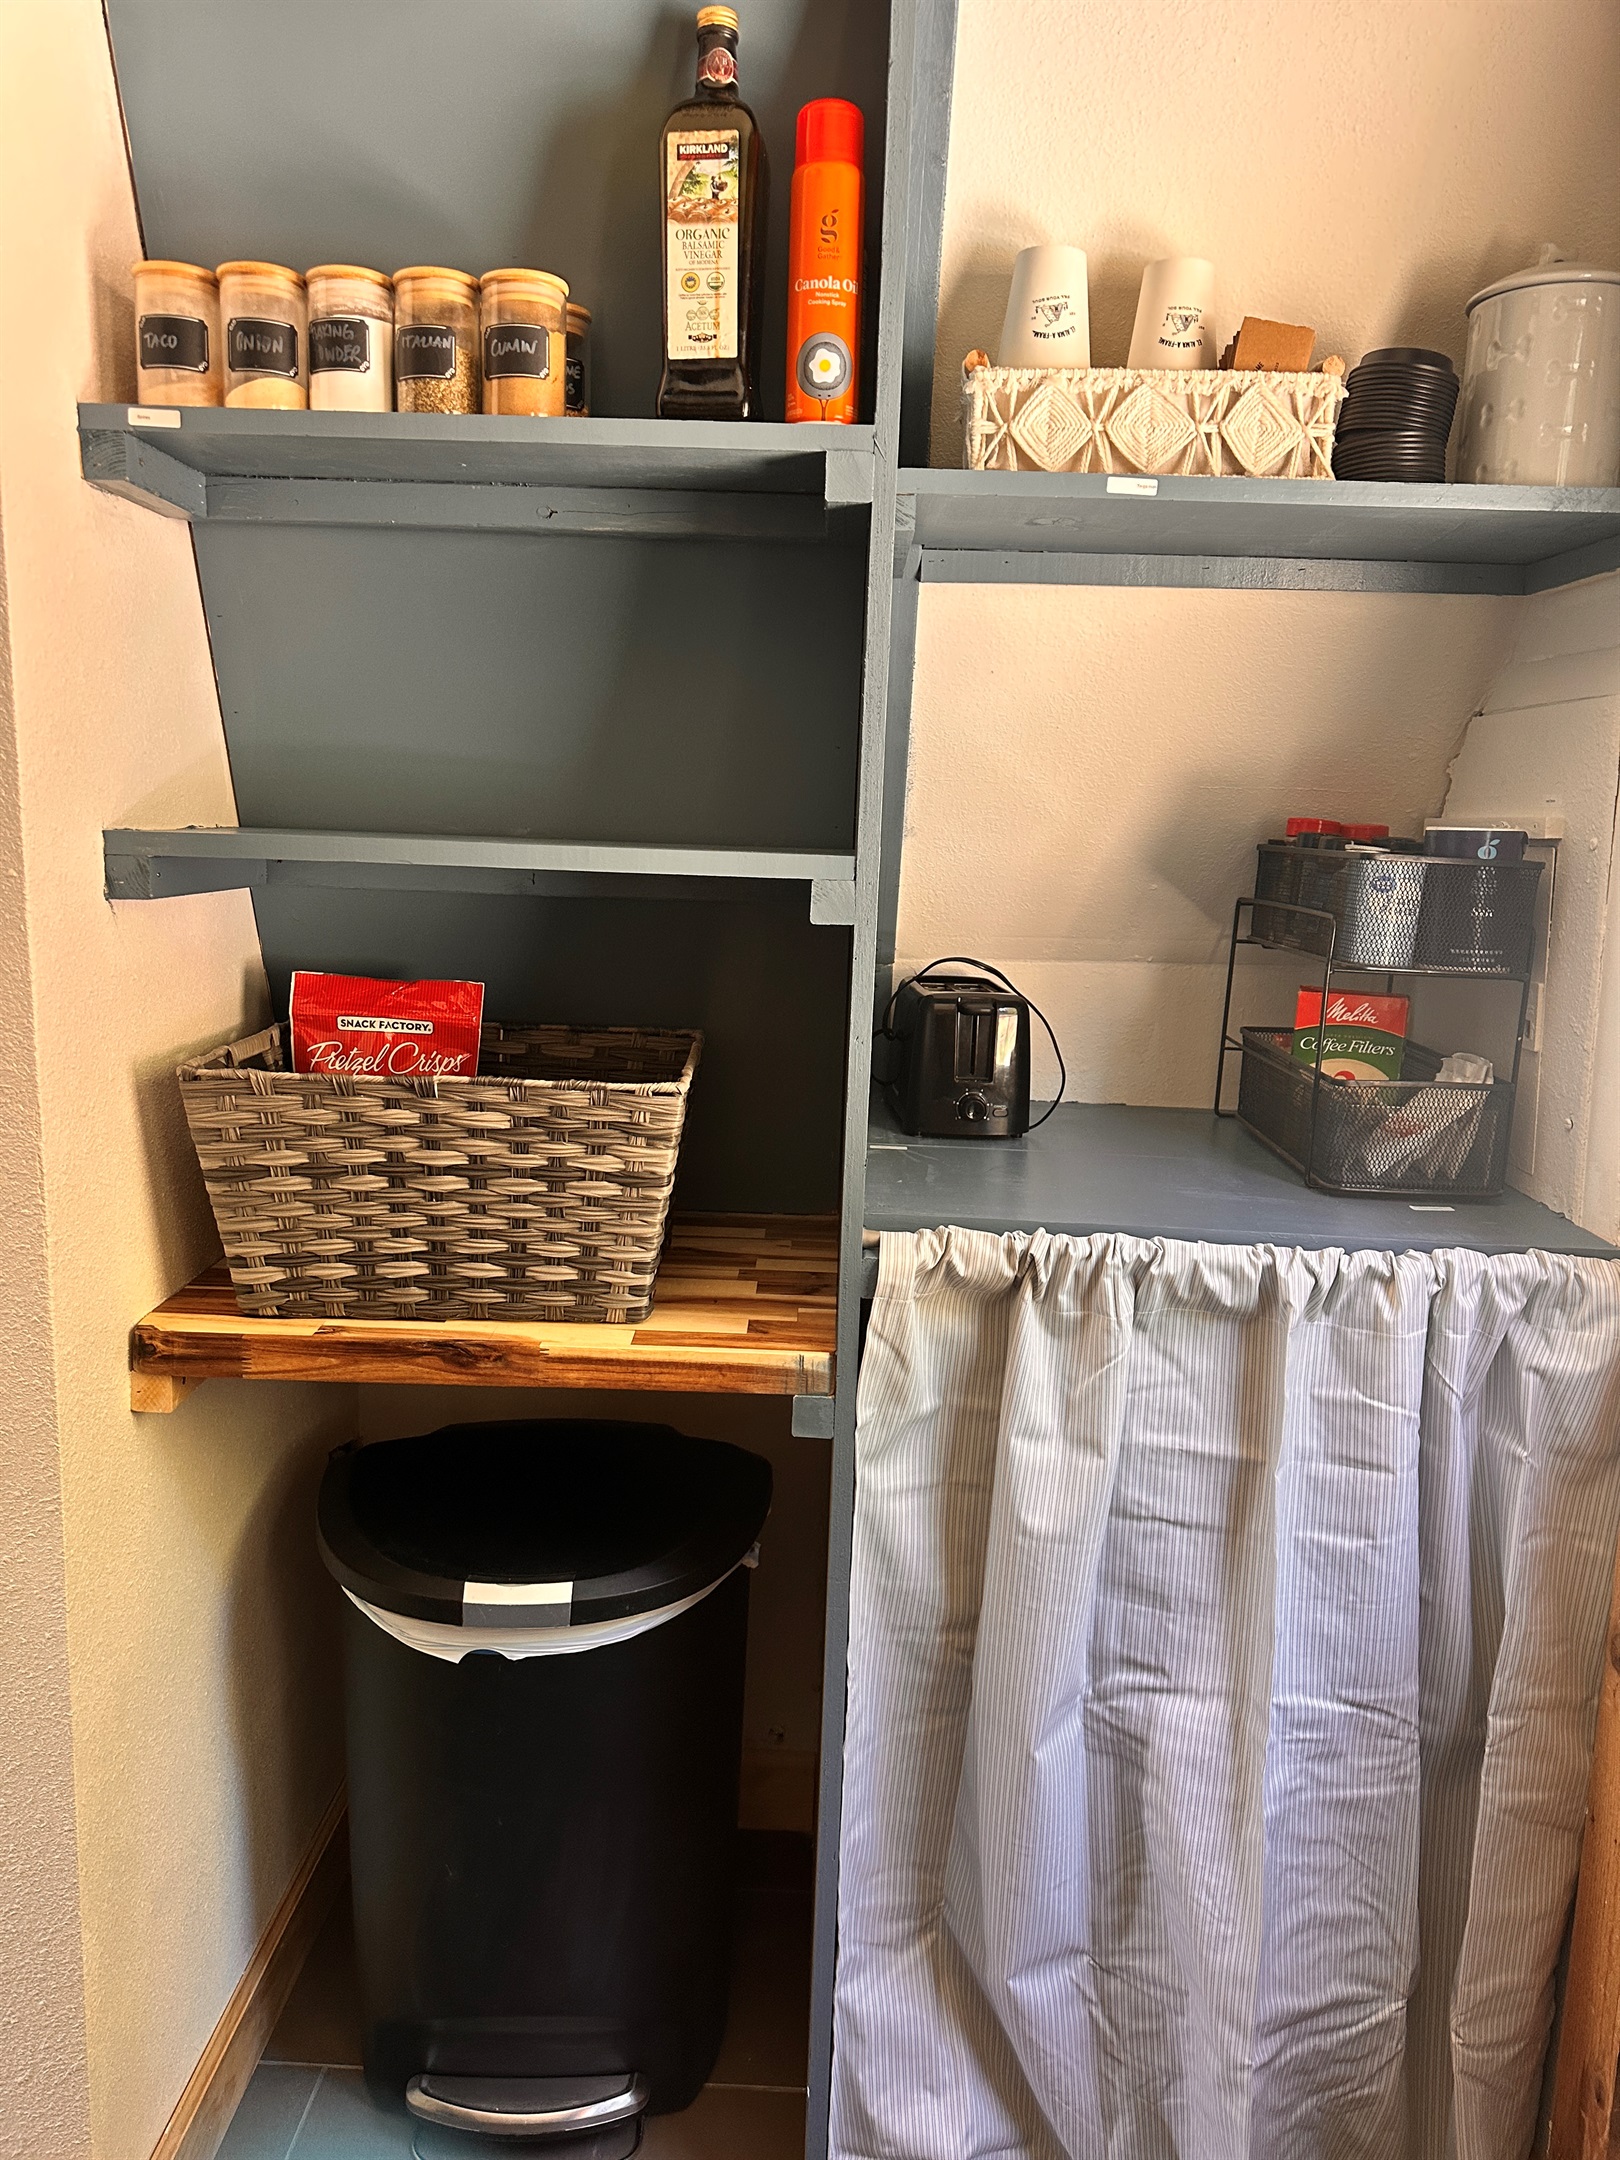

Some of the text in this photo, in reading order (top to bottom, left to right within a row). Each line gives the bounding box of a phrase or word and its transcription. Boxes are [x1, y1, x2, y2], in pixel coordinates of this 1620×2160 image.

[679, 143, 728, 155] KIRKLAND
[675, 227, 730, 241] ORGANIC
[682, 240, 725, 250] BALSAMIC
[683, 250, 723, 259] VINEGAR
[795, 275, 858, 295] Canola Oil
[807, 298, 847, 308] Cooking Spray
[685, 321, 720, 331] ACETUM
[143, 332, 178, 349] TACO
[235, 331, 284, 353] ONION
[401, 334, 452, 349] ITALIAN
[490, 338, 538, 357] CUMIN
[1182, 340, 1196, 349] ALMA
[318, 343, 362, 364] OWDER
[1326, 997, 1379, 1024] Melitta
[340, 1018, 376, 1029] SNACK
[1300, 1036, 1396, 1056] Coffee Filters
[307, 1041, 473, 1076] Pretzel Crisps
